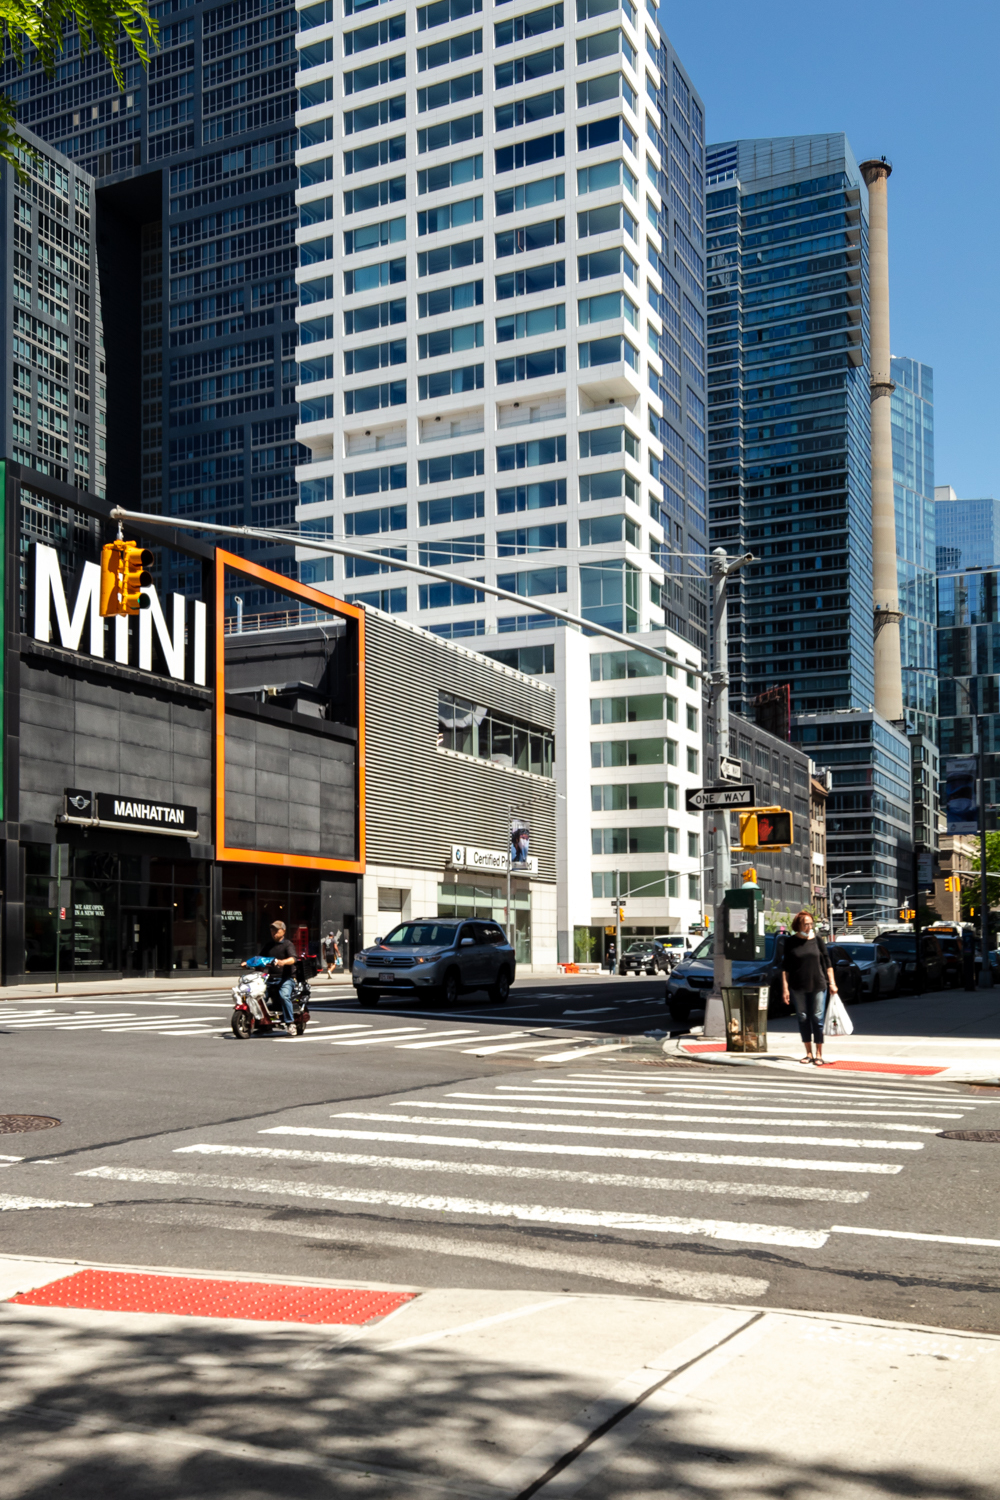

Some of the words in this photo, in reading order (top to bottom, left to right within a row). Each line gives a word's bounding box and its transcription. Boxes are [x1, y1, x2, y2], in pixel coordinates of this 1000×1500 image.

[34, 542, 207, 687] MINI
[695, 794, 715, 804] ONE
[724, 792, 746, 802] WAY
[114, 800, 185, 824] MANHATTAN
[473, 851, 500, 867] Certified
